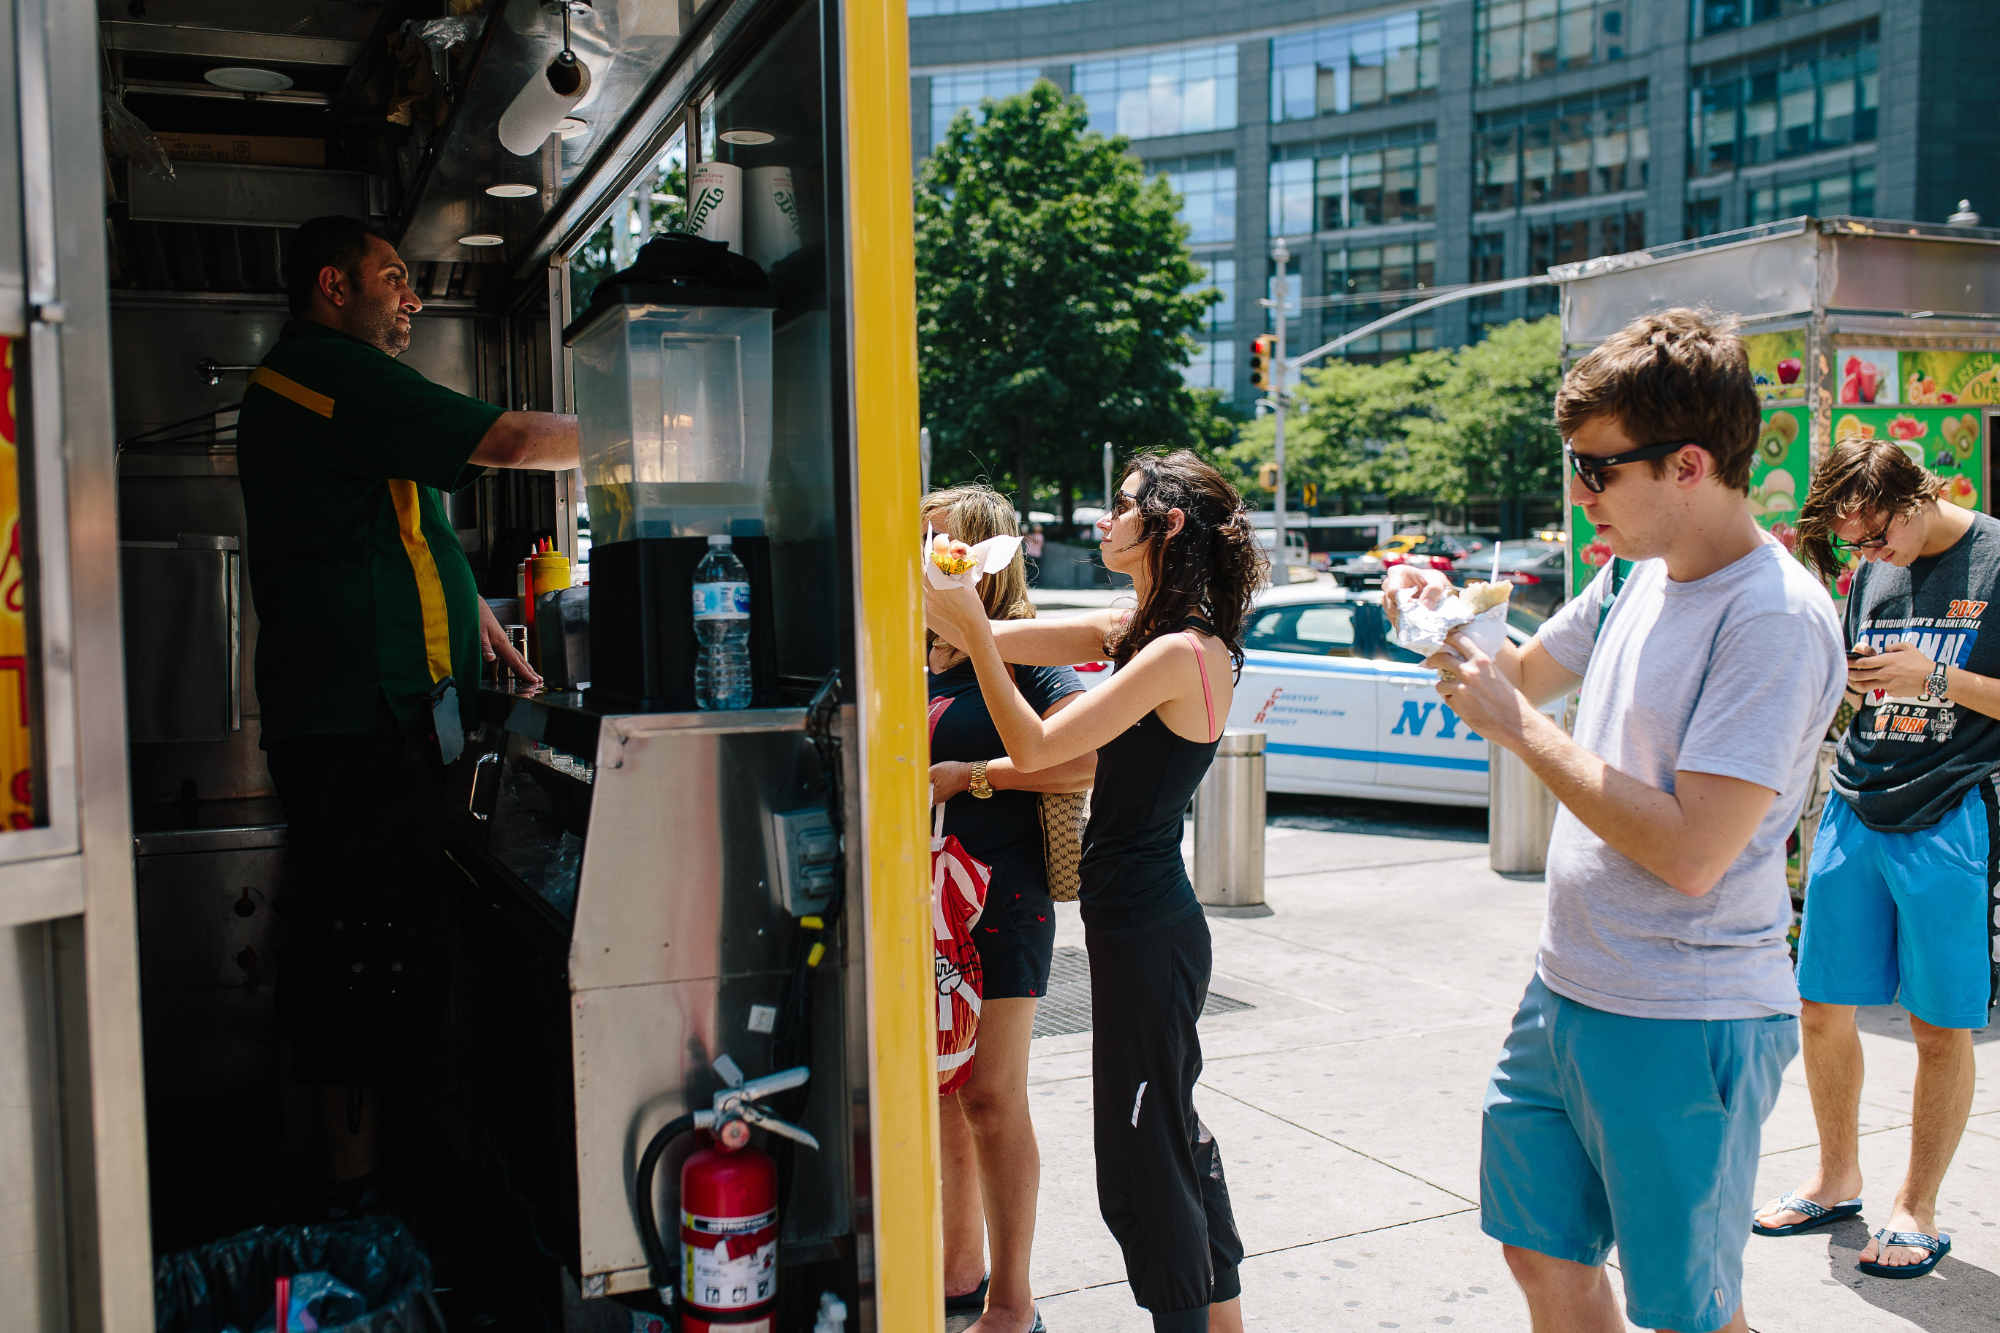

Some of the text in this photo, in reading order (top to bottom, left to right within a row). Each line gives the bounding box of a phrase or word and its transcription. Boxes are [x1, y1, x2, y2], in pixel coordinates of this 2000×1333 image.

[1946, 600, 1988, 618] 2017
[1875, 619, 1906, 629] DIVISION
[1391, 700, 1484, 742] NY
[1890, 715, 1929, 735] YORK
